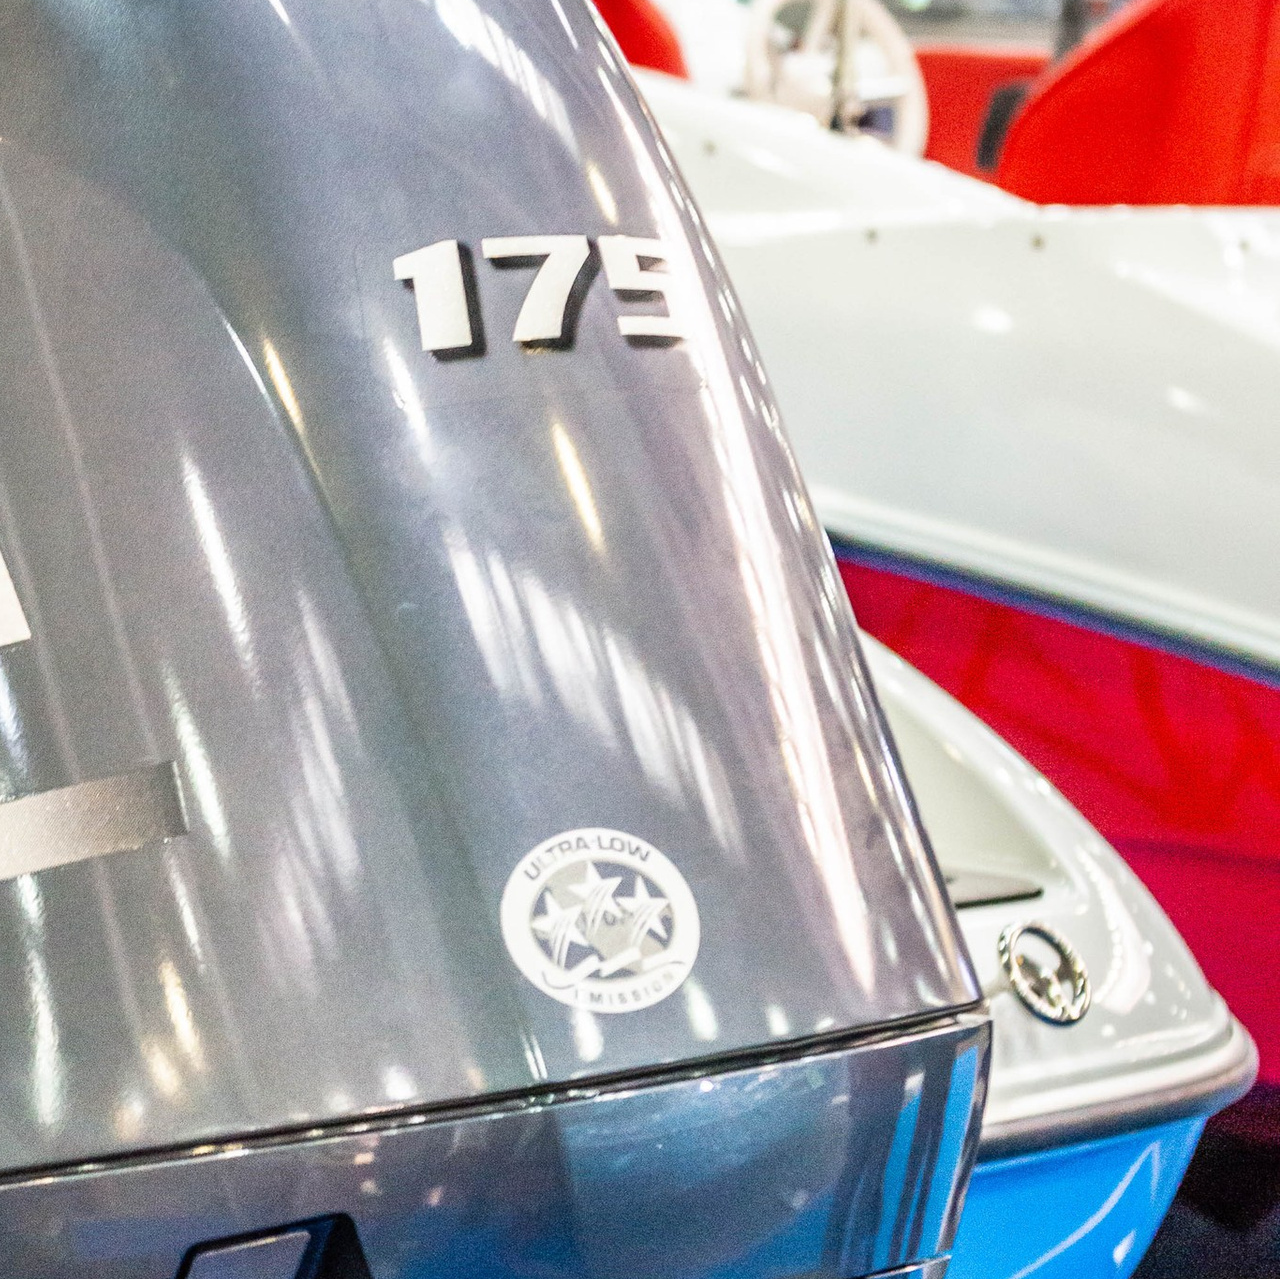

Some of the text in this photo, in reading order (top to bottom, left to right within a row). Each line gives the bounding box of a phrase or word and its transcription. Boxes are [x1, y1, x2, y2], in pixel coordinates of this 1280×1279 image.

[392, 234, 694, 353] 175
[523, 835, 651, 881] ULTRA LOW
